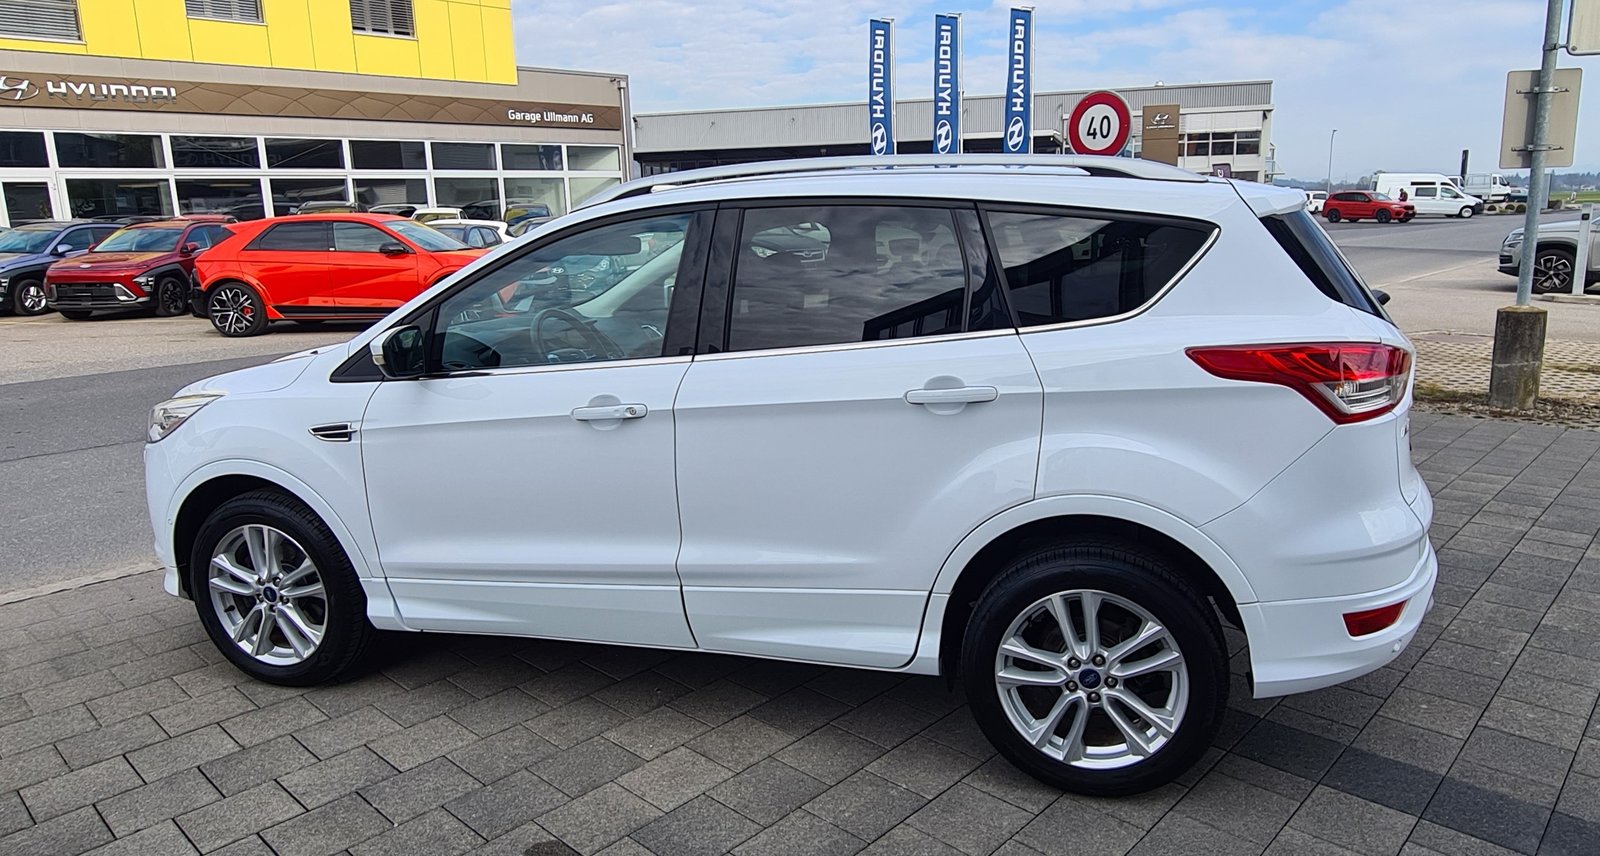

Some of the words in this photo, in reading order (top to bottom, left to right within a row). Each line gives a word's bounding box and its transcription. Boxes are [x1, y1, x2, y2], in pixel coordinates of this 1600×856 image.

[46, 80, 177, 104] HYUNDAI
[508, 110, 541, 123] Garage
[543, 111, 579, 123] Ullmann
[580, 113, 594, 124] AG
[1086, 115, 1112, 140] 40
